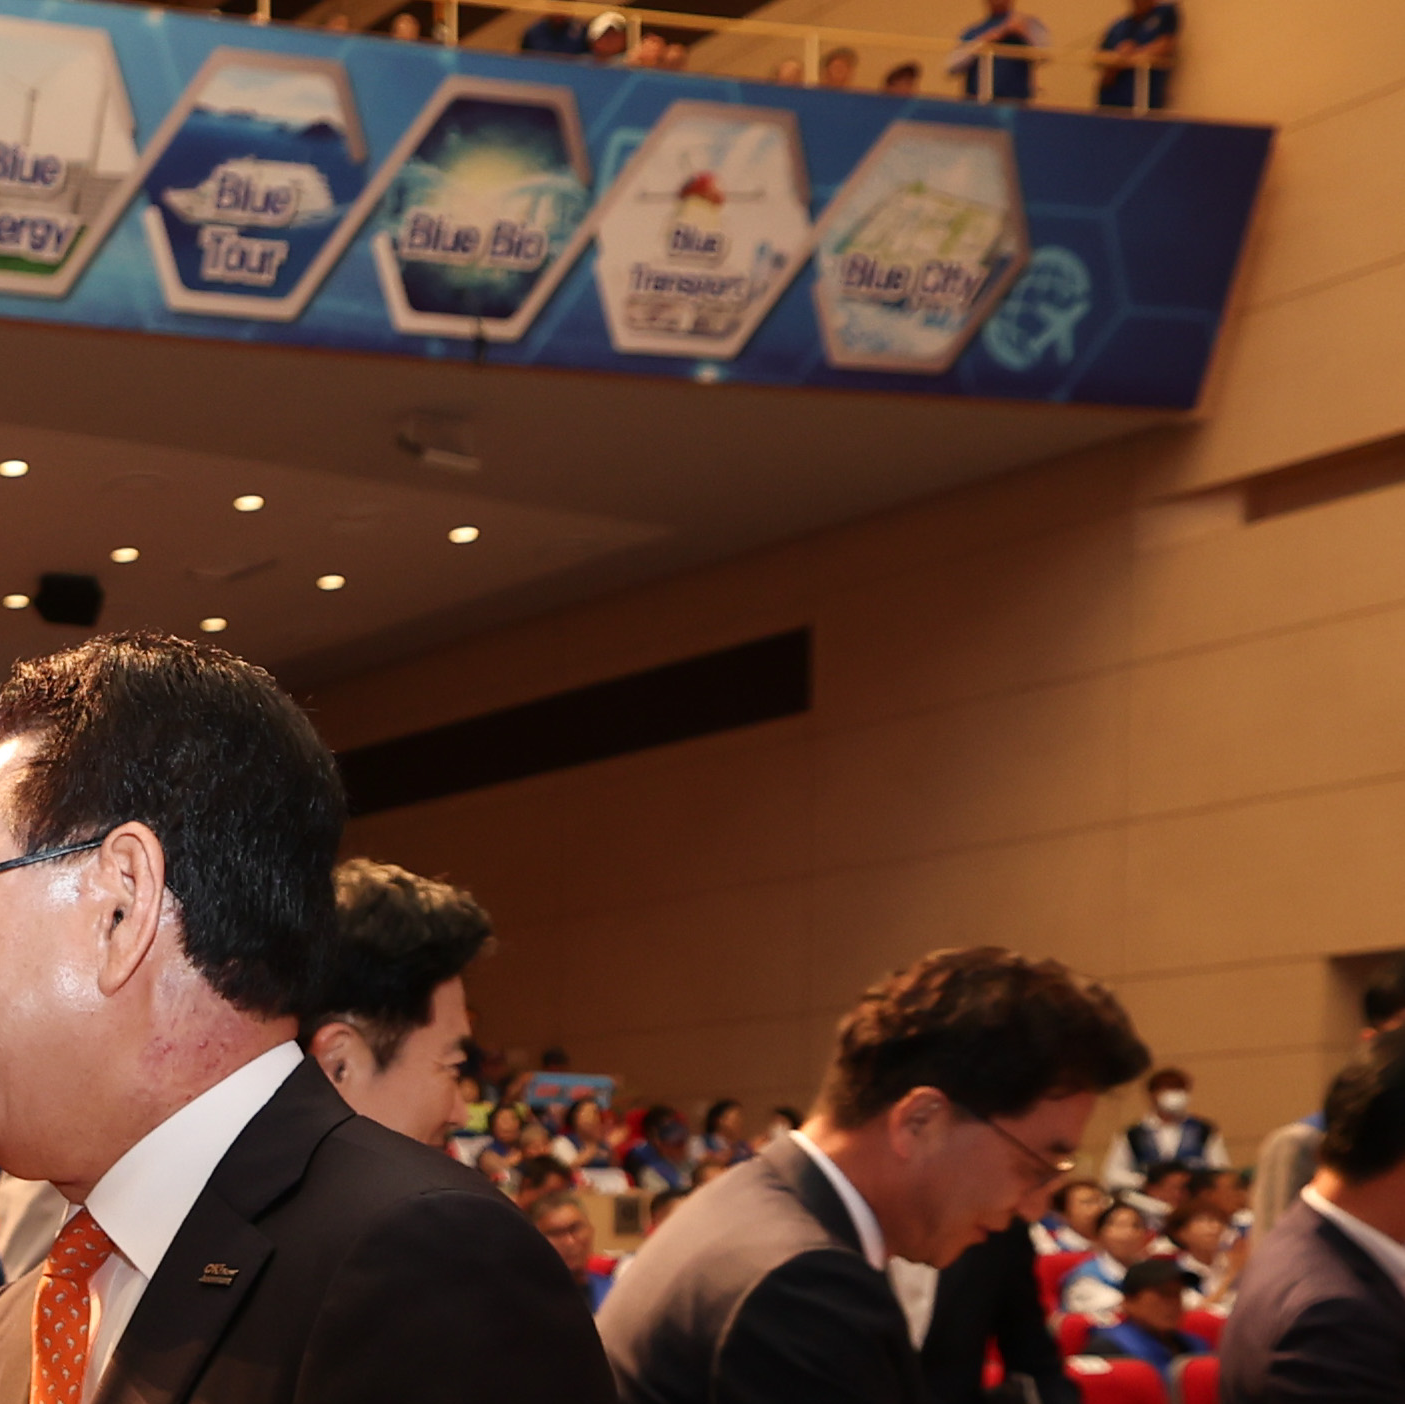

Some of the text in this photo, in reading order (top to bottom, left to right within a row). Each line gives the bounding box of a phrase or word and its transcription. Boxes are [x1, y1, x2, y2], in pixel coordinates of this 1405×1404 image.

[215, 174, 294, 216] Blue
[209, 231, 279, 275] Tour
[408, 212, 546, 261] Blue Bio
[672, 225, 719, 254] Blue
[842, 252, 981, 304] Blue City
